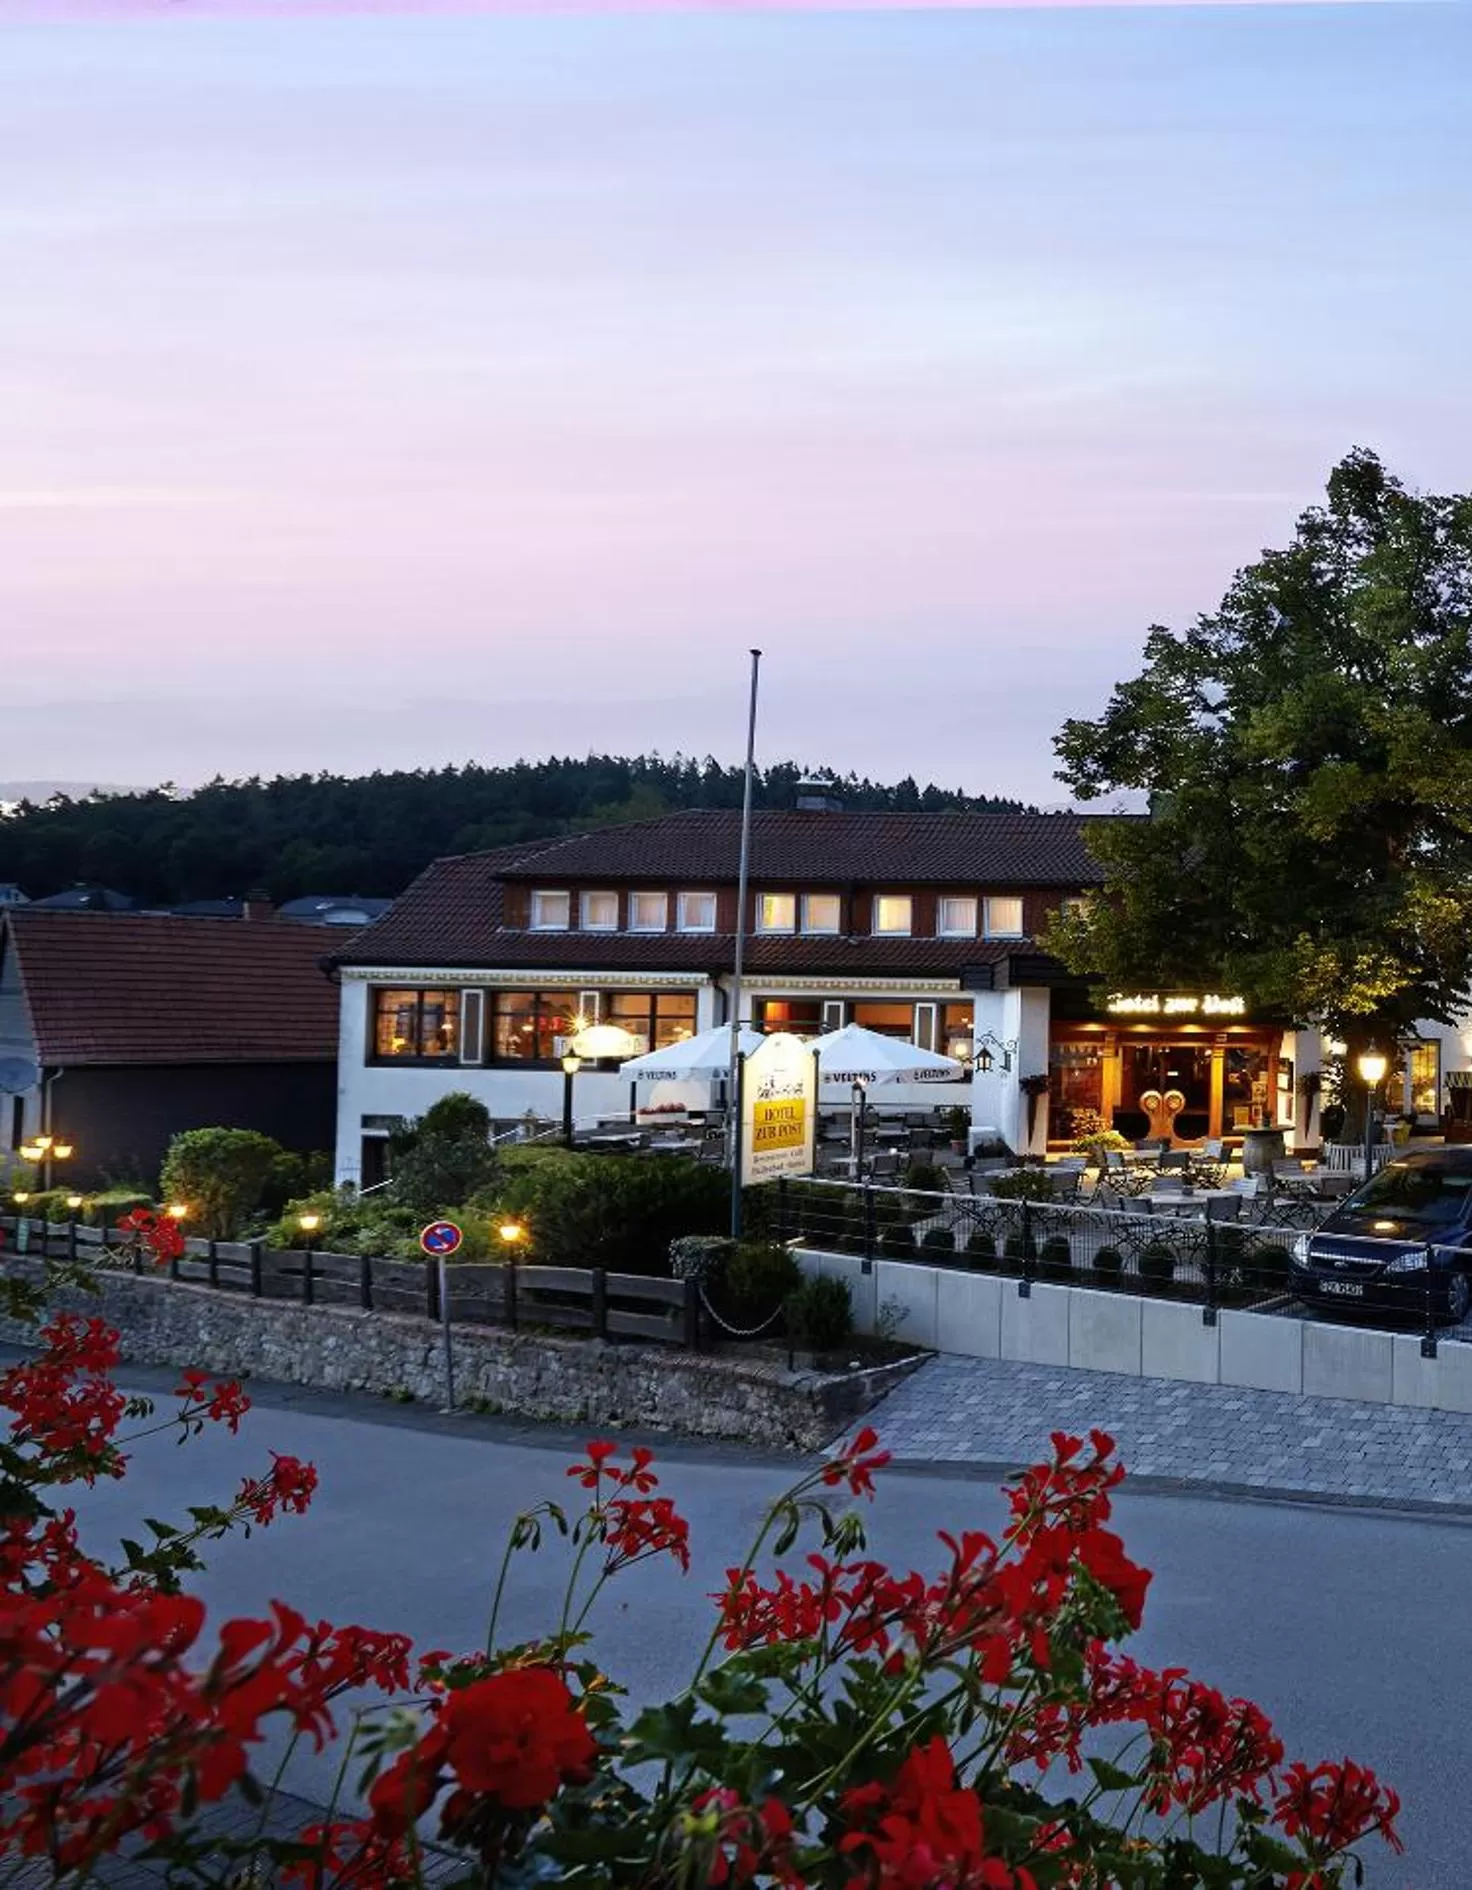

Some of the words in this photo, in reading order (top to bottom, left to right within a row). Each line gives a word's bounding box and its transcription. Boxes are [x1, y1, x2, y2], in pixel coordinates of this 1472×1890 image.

[764, 1105, 796, 1121] HOTEL
[756, 1125, 776, 1140] ZUR
[777, 1122, 802, 1137] POST
